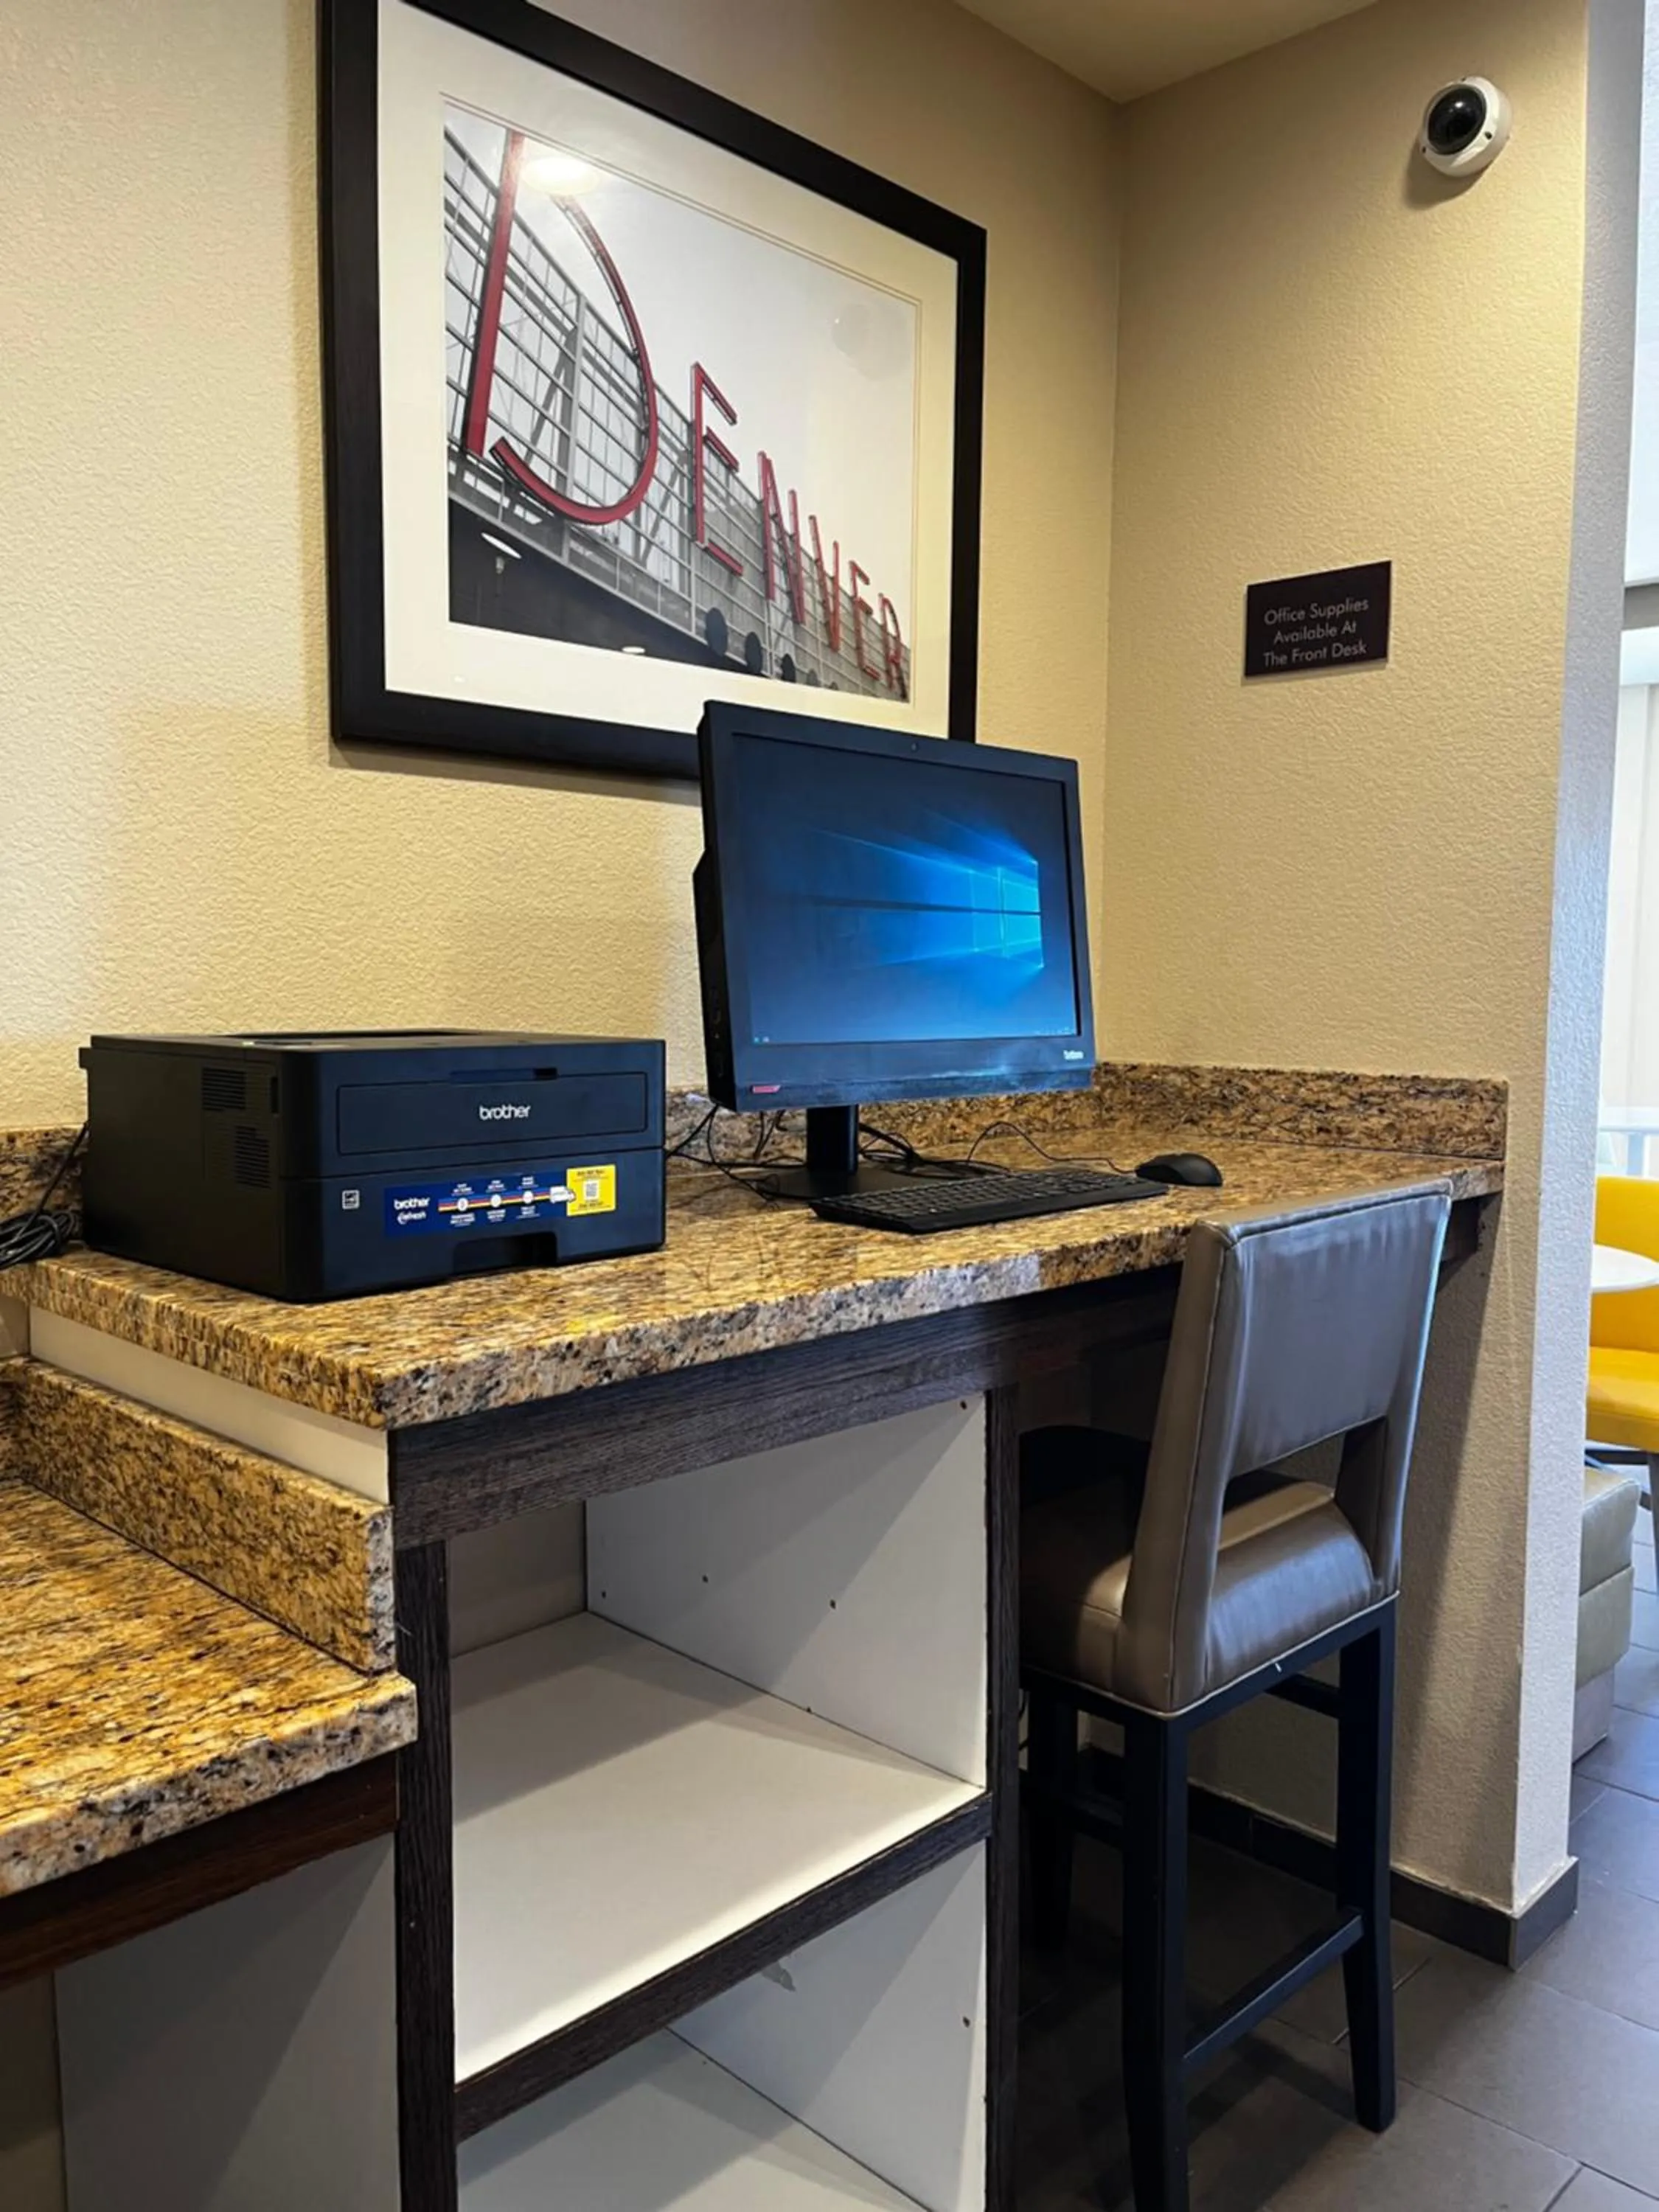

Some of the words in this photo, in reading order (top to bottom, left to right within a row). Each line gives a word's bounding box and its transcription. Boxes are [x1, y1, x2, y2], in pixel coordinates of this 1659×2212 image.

[463, 128, 909, 702] DENVER
[1264, 607, 1305, 625] Office
[1310, 597, 1369, 619] Supplies
[1273, 623, 1338, 644] Available
[1340, 620, 1357, 634] At
[1263, 651, 1288, 667] The
[1292, 646, 1328, 663] Front
[1332, 639, 1368, 658] Desk
[479, 1104, 531, 1121] brother
[393, 1197, 431, 1210] brother
